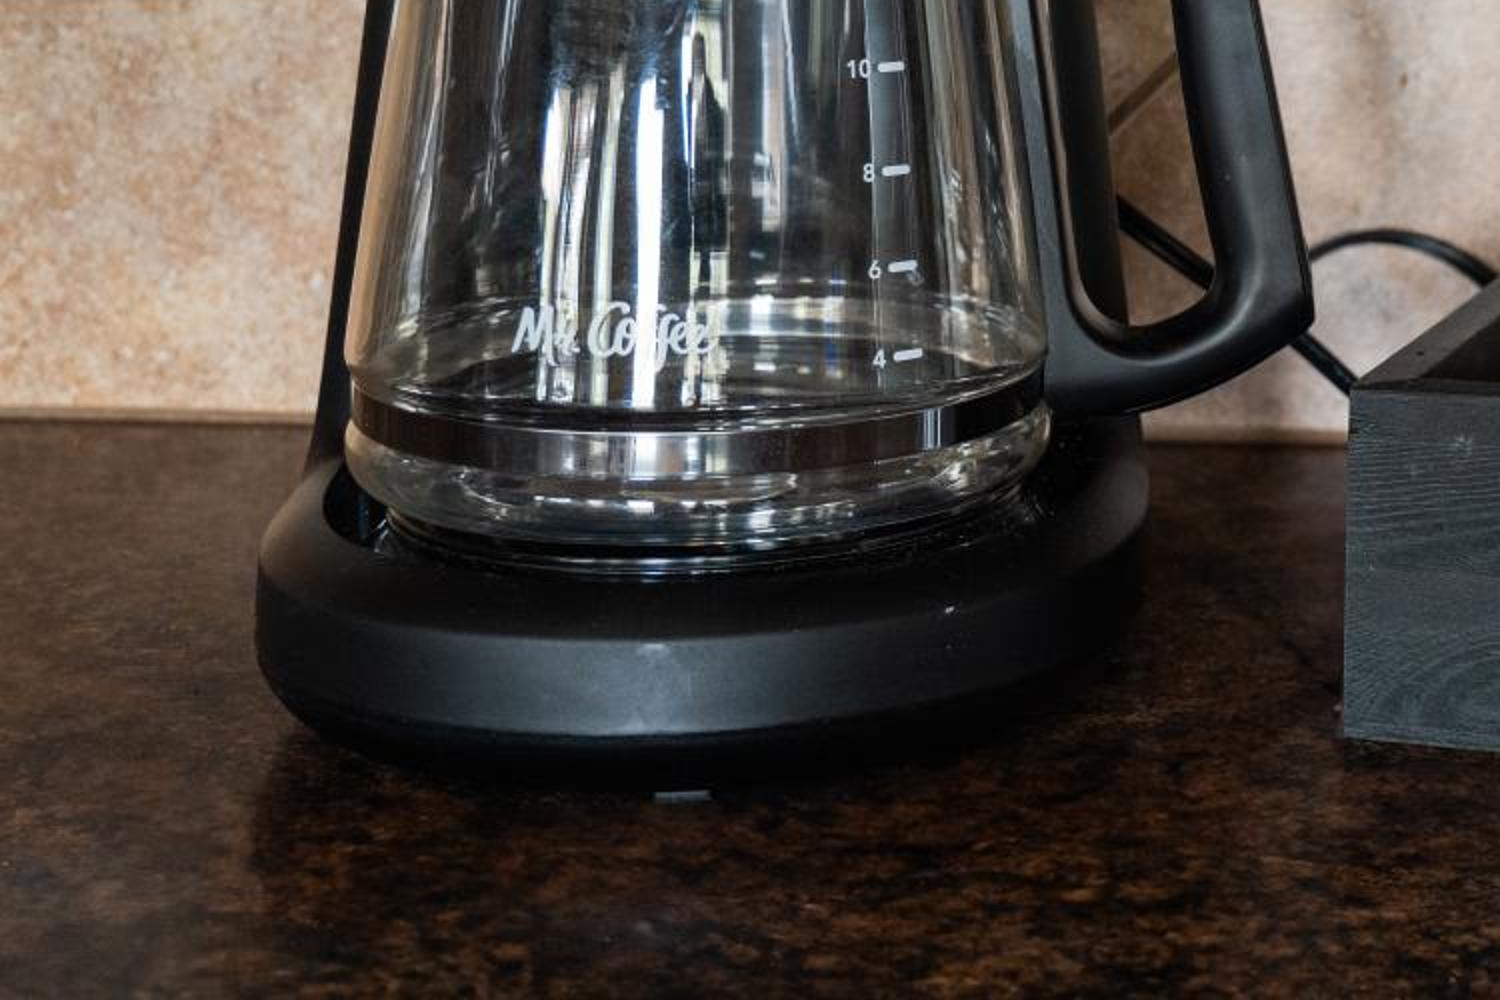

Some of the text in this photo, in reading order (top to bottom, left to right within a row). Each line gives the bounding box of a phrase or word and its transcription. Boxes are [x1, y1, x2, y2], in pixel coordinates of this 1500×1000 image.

[847, 59, 872, 79] 10
[863, 163, 875, 182] 8
[868, 260, 882, 279] 6
[586, 301, 714, 374] Cofee
[872, 348, 887, 369] 4
